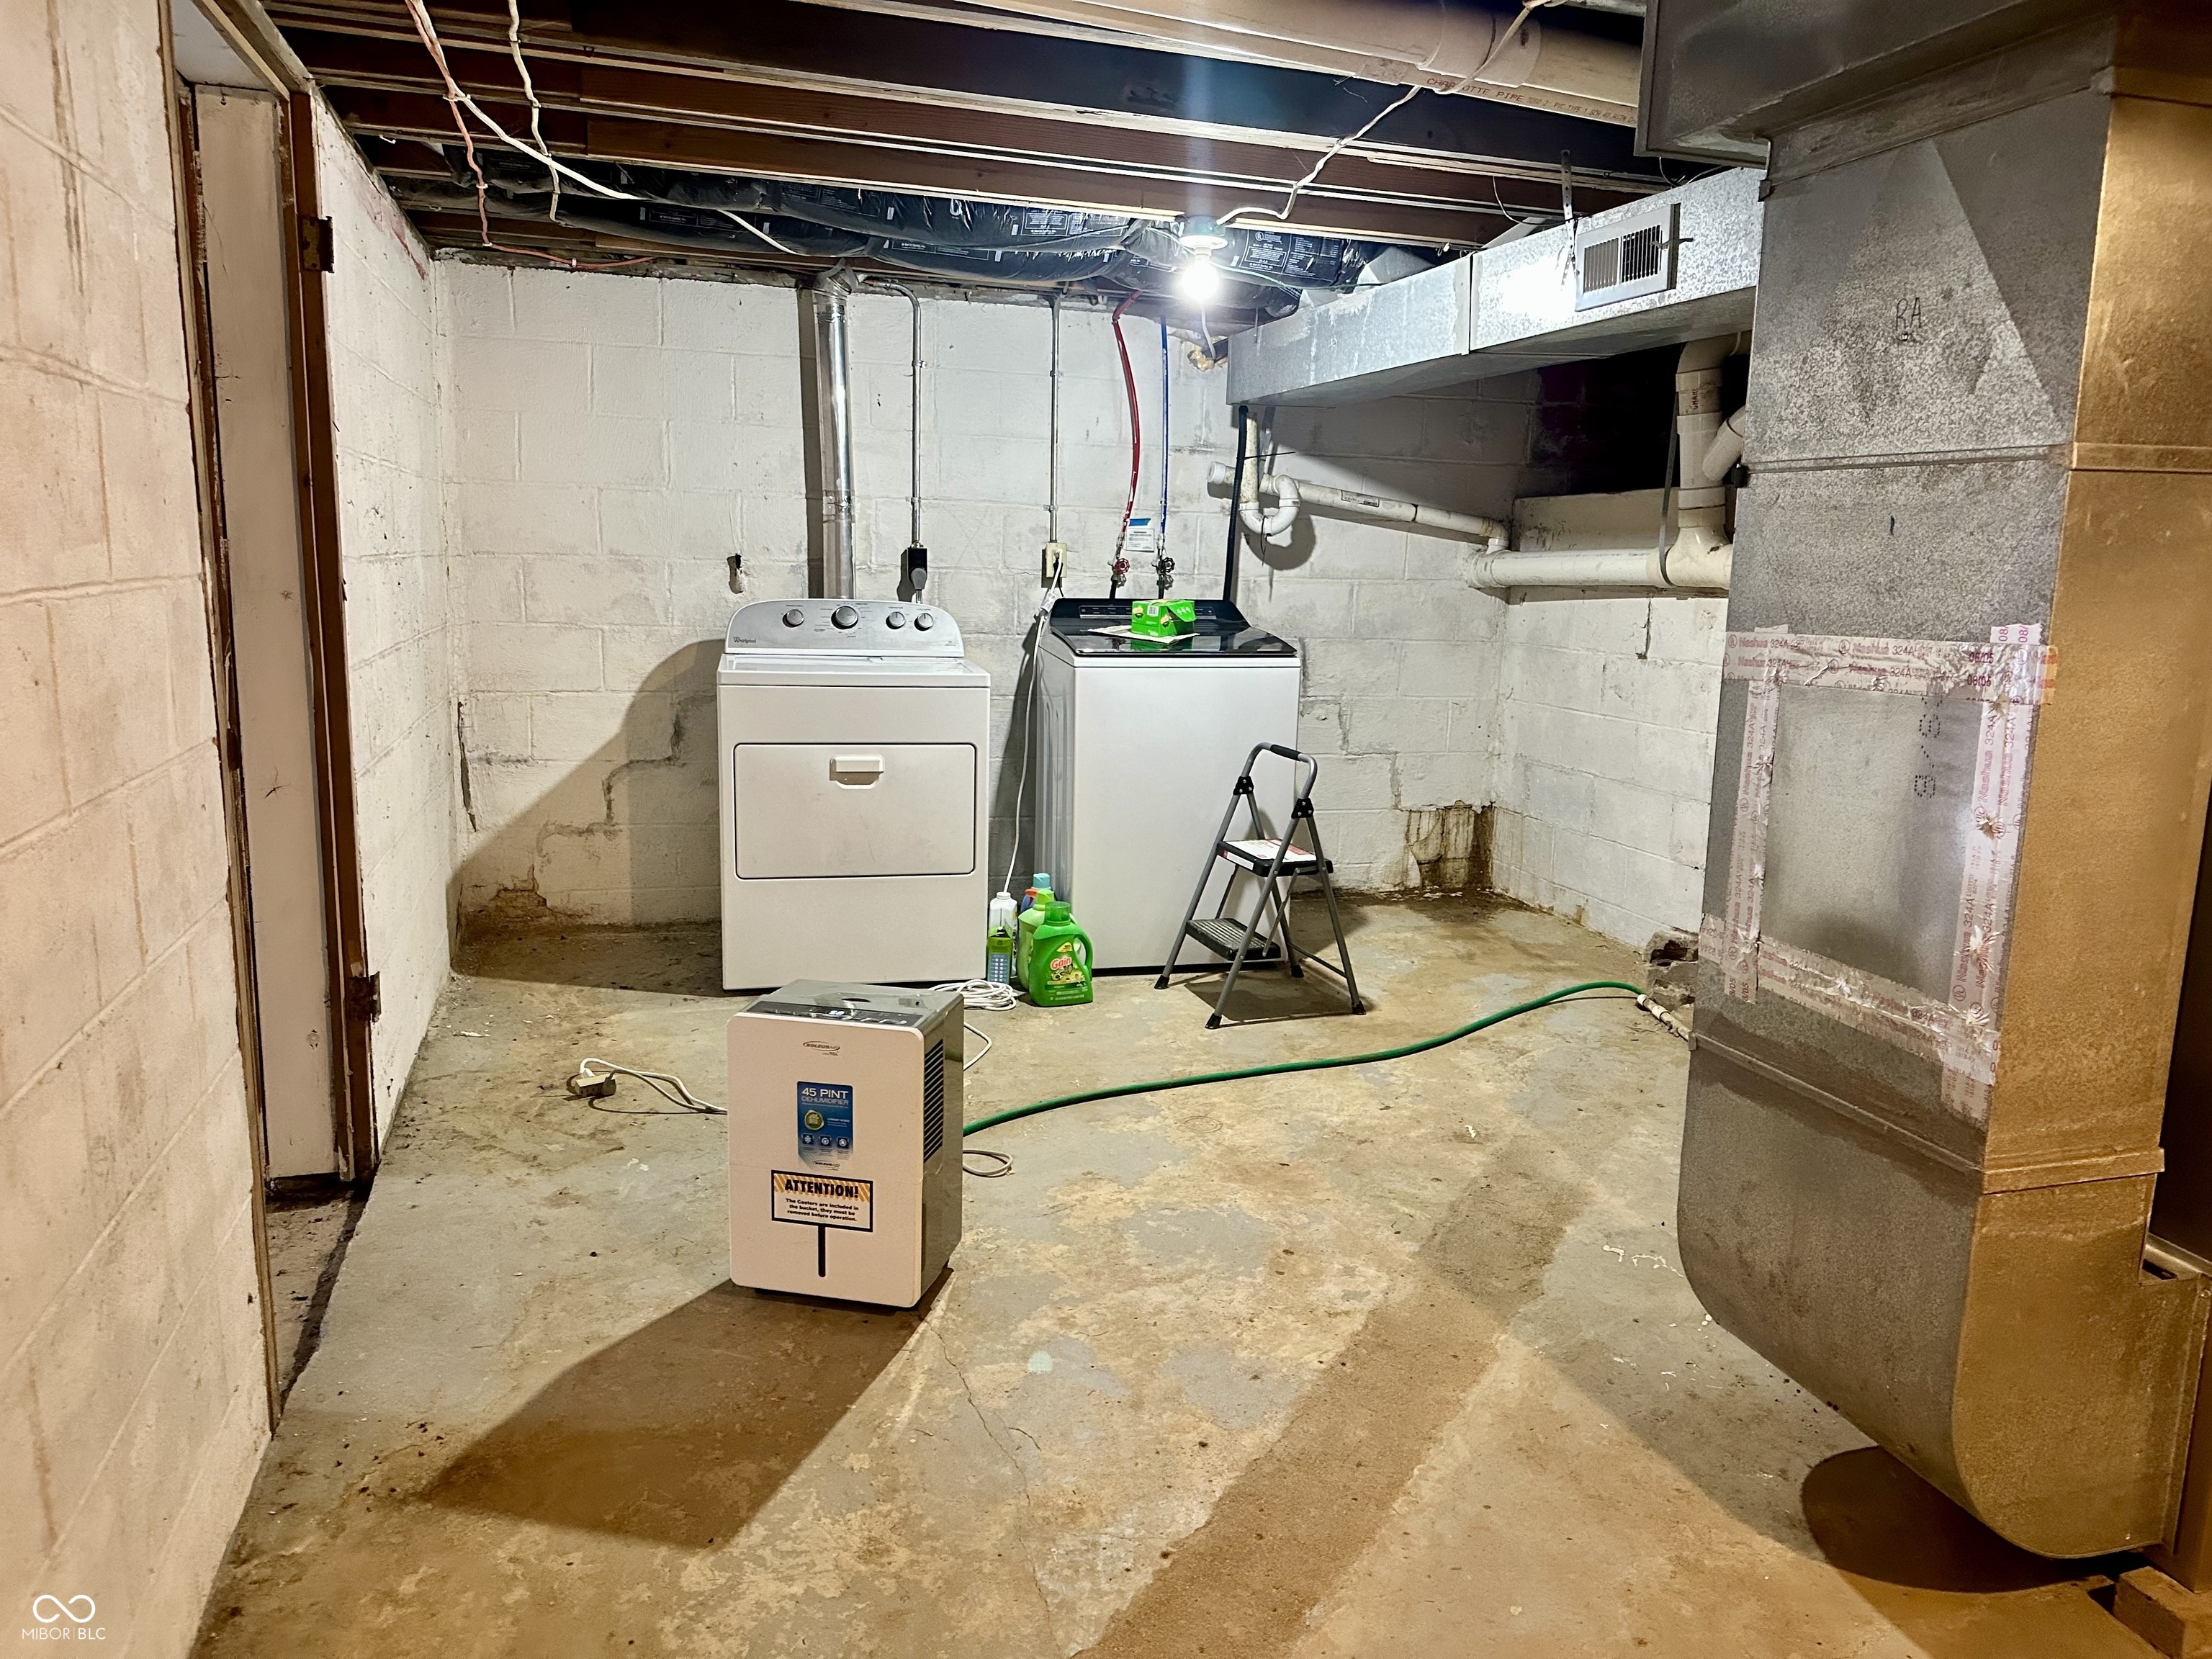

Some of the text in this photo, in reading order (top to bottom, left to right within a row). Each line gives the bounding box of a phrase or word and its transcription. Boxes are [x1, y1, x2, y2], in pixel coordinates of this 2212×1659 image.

[1426, 78, 1491, 96] CHAROTTE
[1496, 91, 1525, 102] PIPE
[1895, 297, 1922, 331] RA
[1770, 638, 1789, 649] 324A
[1852, 642, 1889, 656] Nashua
[1892, 644, 1914, 656] 324A
[1889, 665, 1912, 678] 324A
[1747, 722, 1755, 748] 324A
[1984, 714, 1997, 746] 324A
[1997, 752, 2013, 806] Nashua
[2005, 716, 2017, 749] 324A
[1978, 750, 1993, 803] Nashua
[1747, 877, 1755, 903] 324A
[1982, 903, 1995, 933] 324A
[1956, 932, 1972, 983] Nashua
[1964, 898, 1975, 928] 324A
[1051, 957, 1072, 970] Gain
[801, 1087, 849, 1100] 45 PINT
[801, 1096, 850, 1106] DEHUMIDIFIER
[785, 1179, 859, 1199] ATTENTION!
